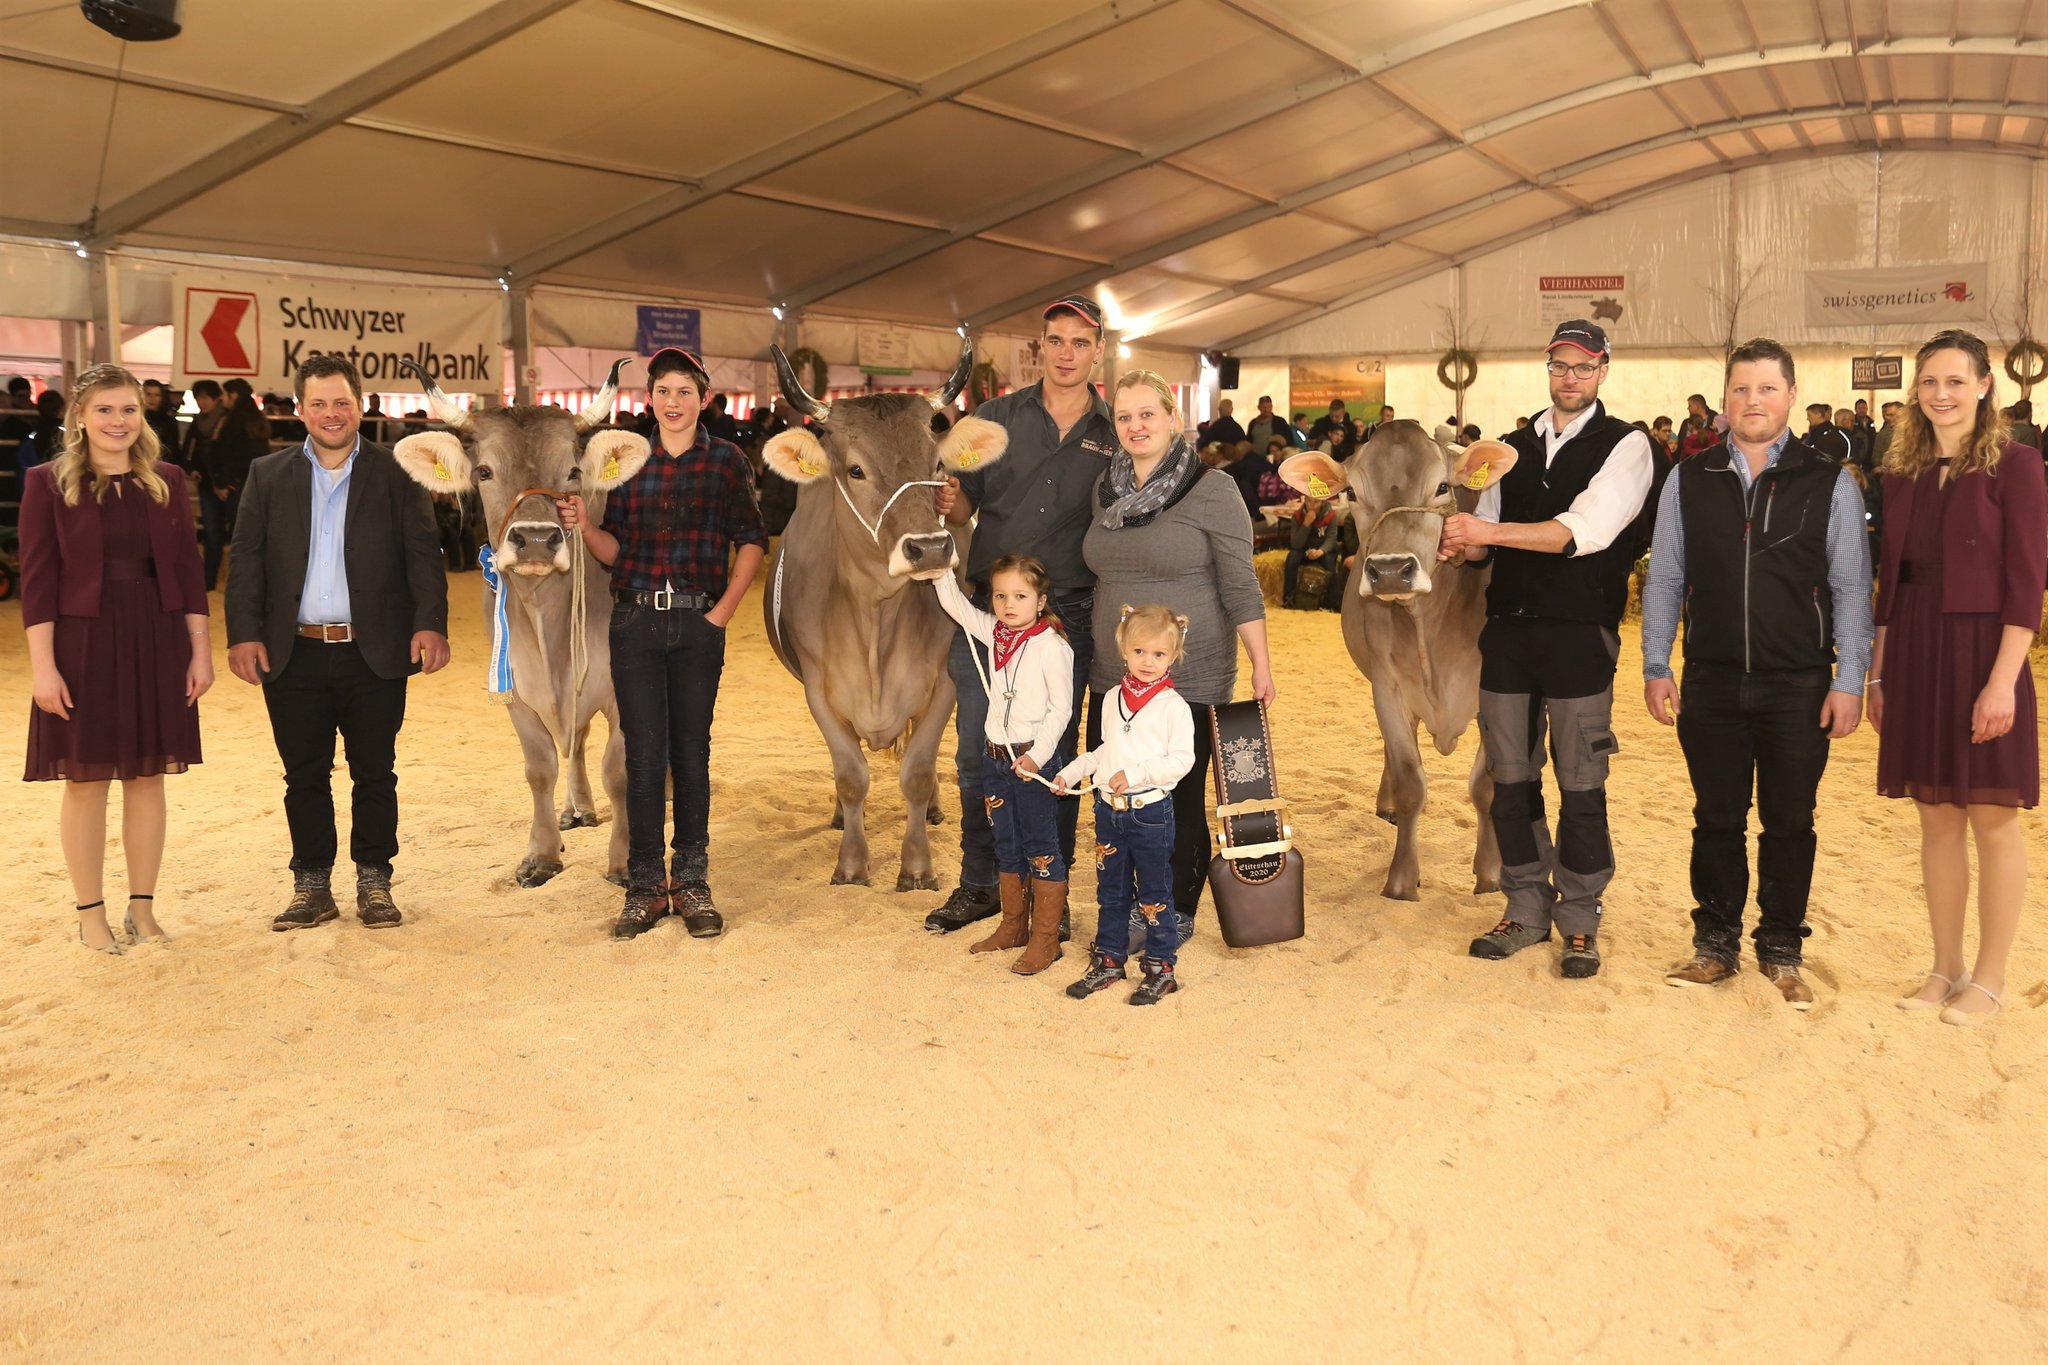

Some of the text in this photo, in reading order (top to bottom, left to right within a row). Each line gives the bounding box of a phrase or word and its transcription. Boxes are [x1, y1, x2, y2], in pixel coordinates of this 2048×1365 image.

[1542, 278, 1622, 289] VIEHHANDEL
[1822, 288, 1937, 312] swissgenetics
[279, 297, 405, 341] Schwyzer
[283, 339, 490, 381] Ktonalbank
[1238, 860, 1278, 871] Eliteschau
[1249, 868, 1269, 877] 2020
